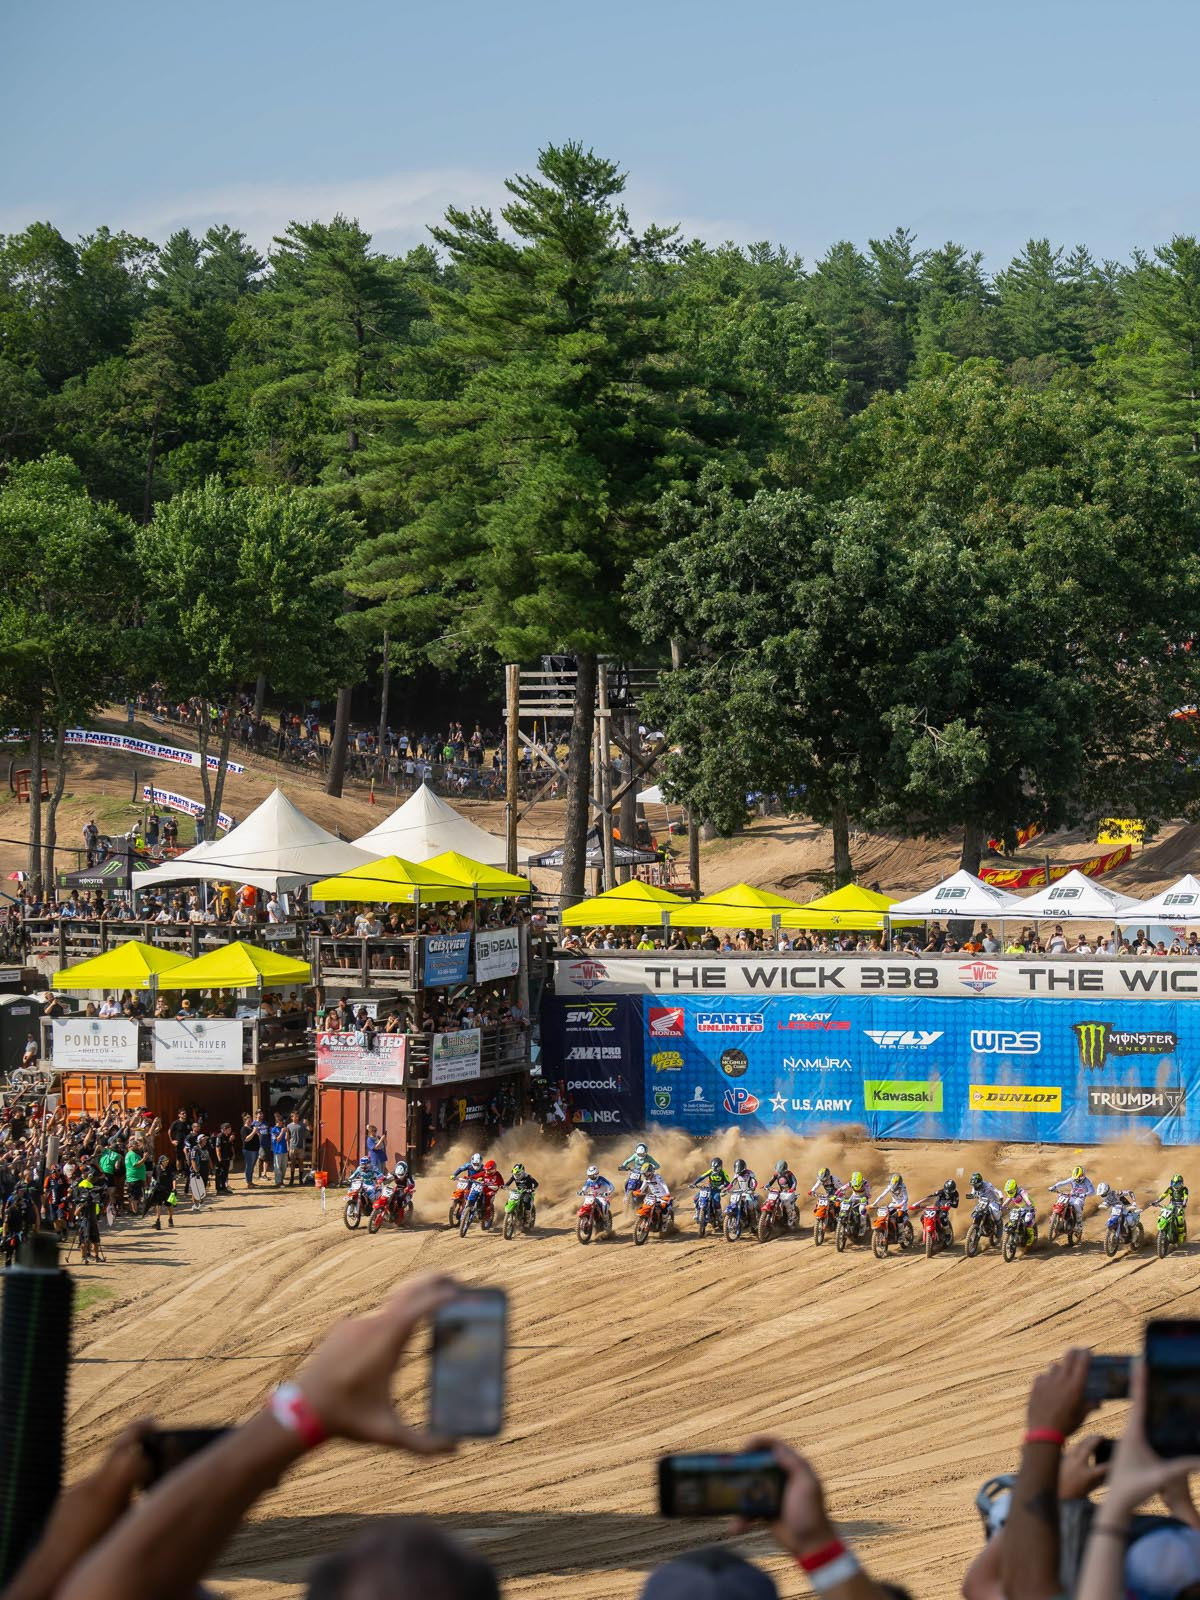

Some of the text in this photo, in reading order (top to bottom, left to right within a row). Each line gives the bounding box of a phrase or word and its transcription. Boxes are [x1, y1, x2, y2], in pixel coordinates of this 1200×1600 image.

[85, 731, 193, 760] PARTS PARTS PARTS
[428, 938, 466, 952] CRESTVIEW
[490, 938, 518, 952] IDEAL
[645, 967, 939, 989] THE WICK 338
[973, 967, 997, 980] WICK
[1019, 968, 1104, 990] THE
[566, 1007, 614, 1026] SMX
[698, 1013, 763, 1024] PARTS
[789, 1012, 832, 1021] MX-ATV
[698, 1024, 764, 1032] UNLIMITED
[64, 1034, 128, 1047] PONDERS
[864, 1029, 945, 1045] FLY
[970, 1029, 1041, 1054] WPS
[1108, 1032, 1174, 1045] MONSTER
[172, 1040, 227, 1049] MILL RIVER
[565, 1046, 621, 1060] AMA PRO
[652, 1051, 681, 1064] MOTO
[656, 1058, 684, 1073] TEES
[783, 1056, 852, 1069] NAMURA
[567, 1076, 617, 1091] peacock
[660, 1096, 666, 1106] 2
[724, 1088, 749, 1114] VP
[873, 1089, 933, 1102] Kawasaki
[986, 1093, 1057, 1103] DUNLOP
[1090, 1092, 1163, 1106] TRIUMPH
[791, 1099, 852, 1111] U.S. ARMY
[594, 1110, 620, 1123] NBC
